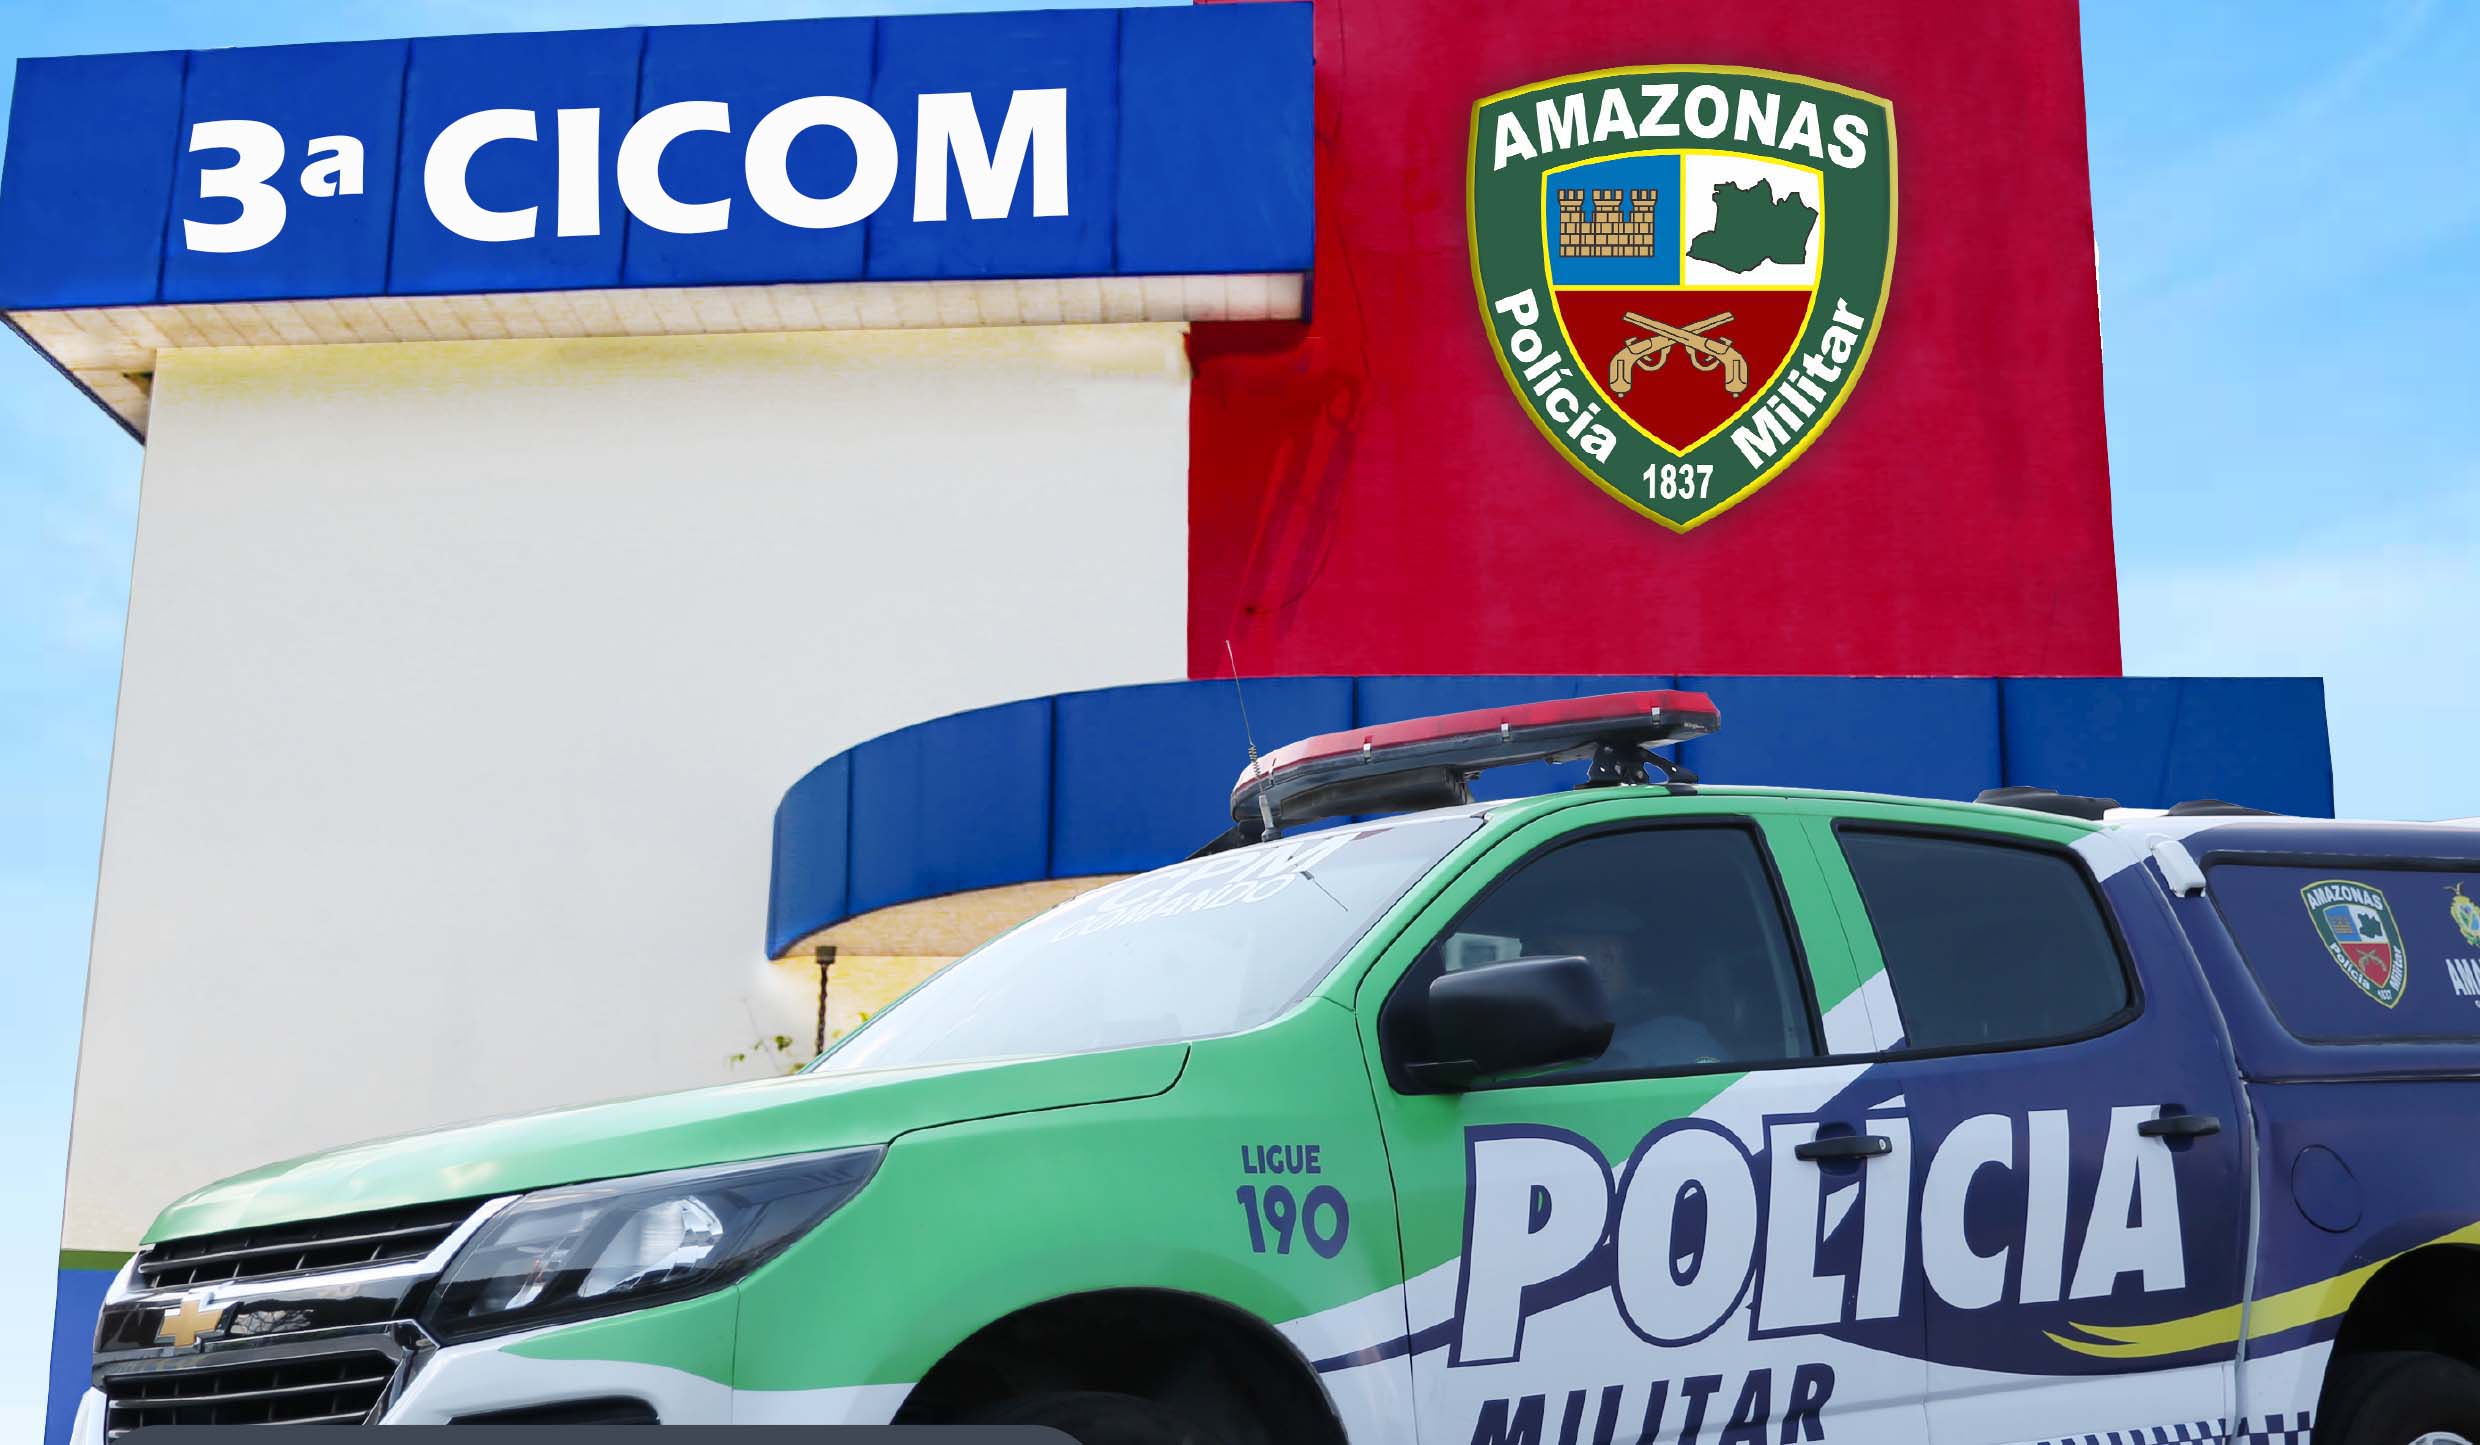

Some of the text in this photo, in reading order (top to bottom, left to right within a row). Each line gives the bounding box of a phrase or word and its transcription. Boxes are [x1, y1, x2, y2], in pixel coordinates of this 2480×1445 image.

[423, 87, 1070, 242] CICOM
[1493, 83, 1869, 171] AMAZONAS
[1495, 288, 1618, 464] Polícia
[1730, 297, 1867, 470] Militar
[1642, 464, 1714, 500] 1837
[2307, 885, 2384, 911] AMAZONAS
[2389, 945, 2404, 992] Militar
[1241, 1145, 1322, 1174] LIGUE
[1236, 1184, 1350, 1260] 190
[1452, 1096, 2187, 1366] POLÍCIA
[1470, 1363, 1836, 1445] MILITAR
